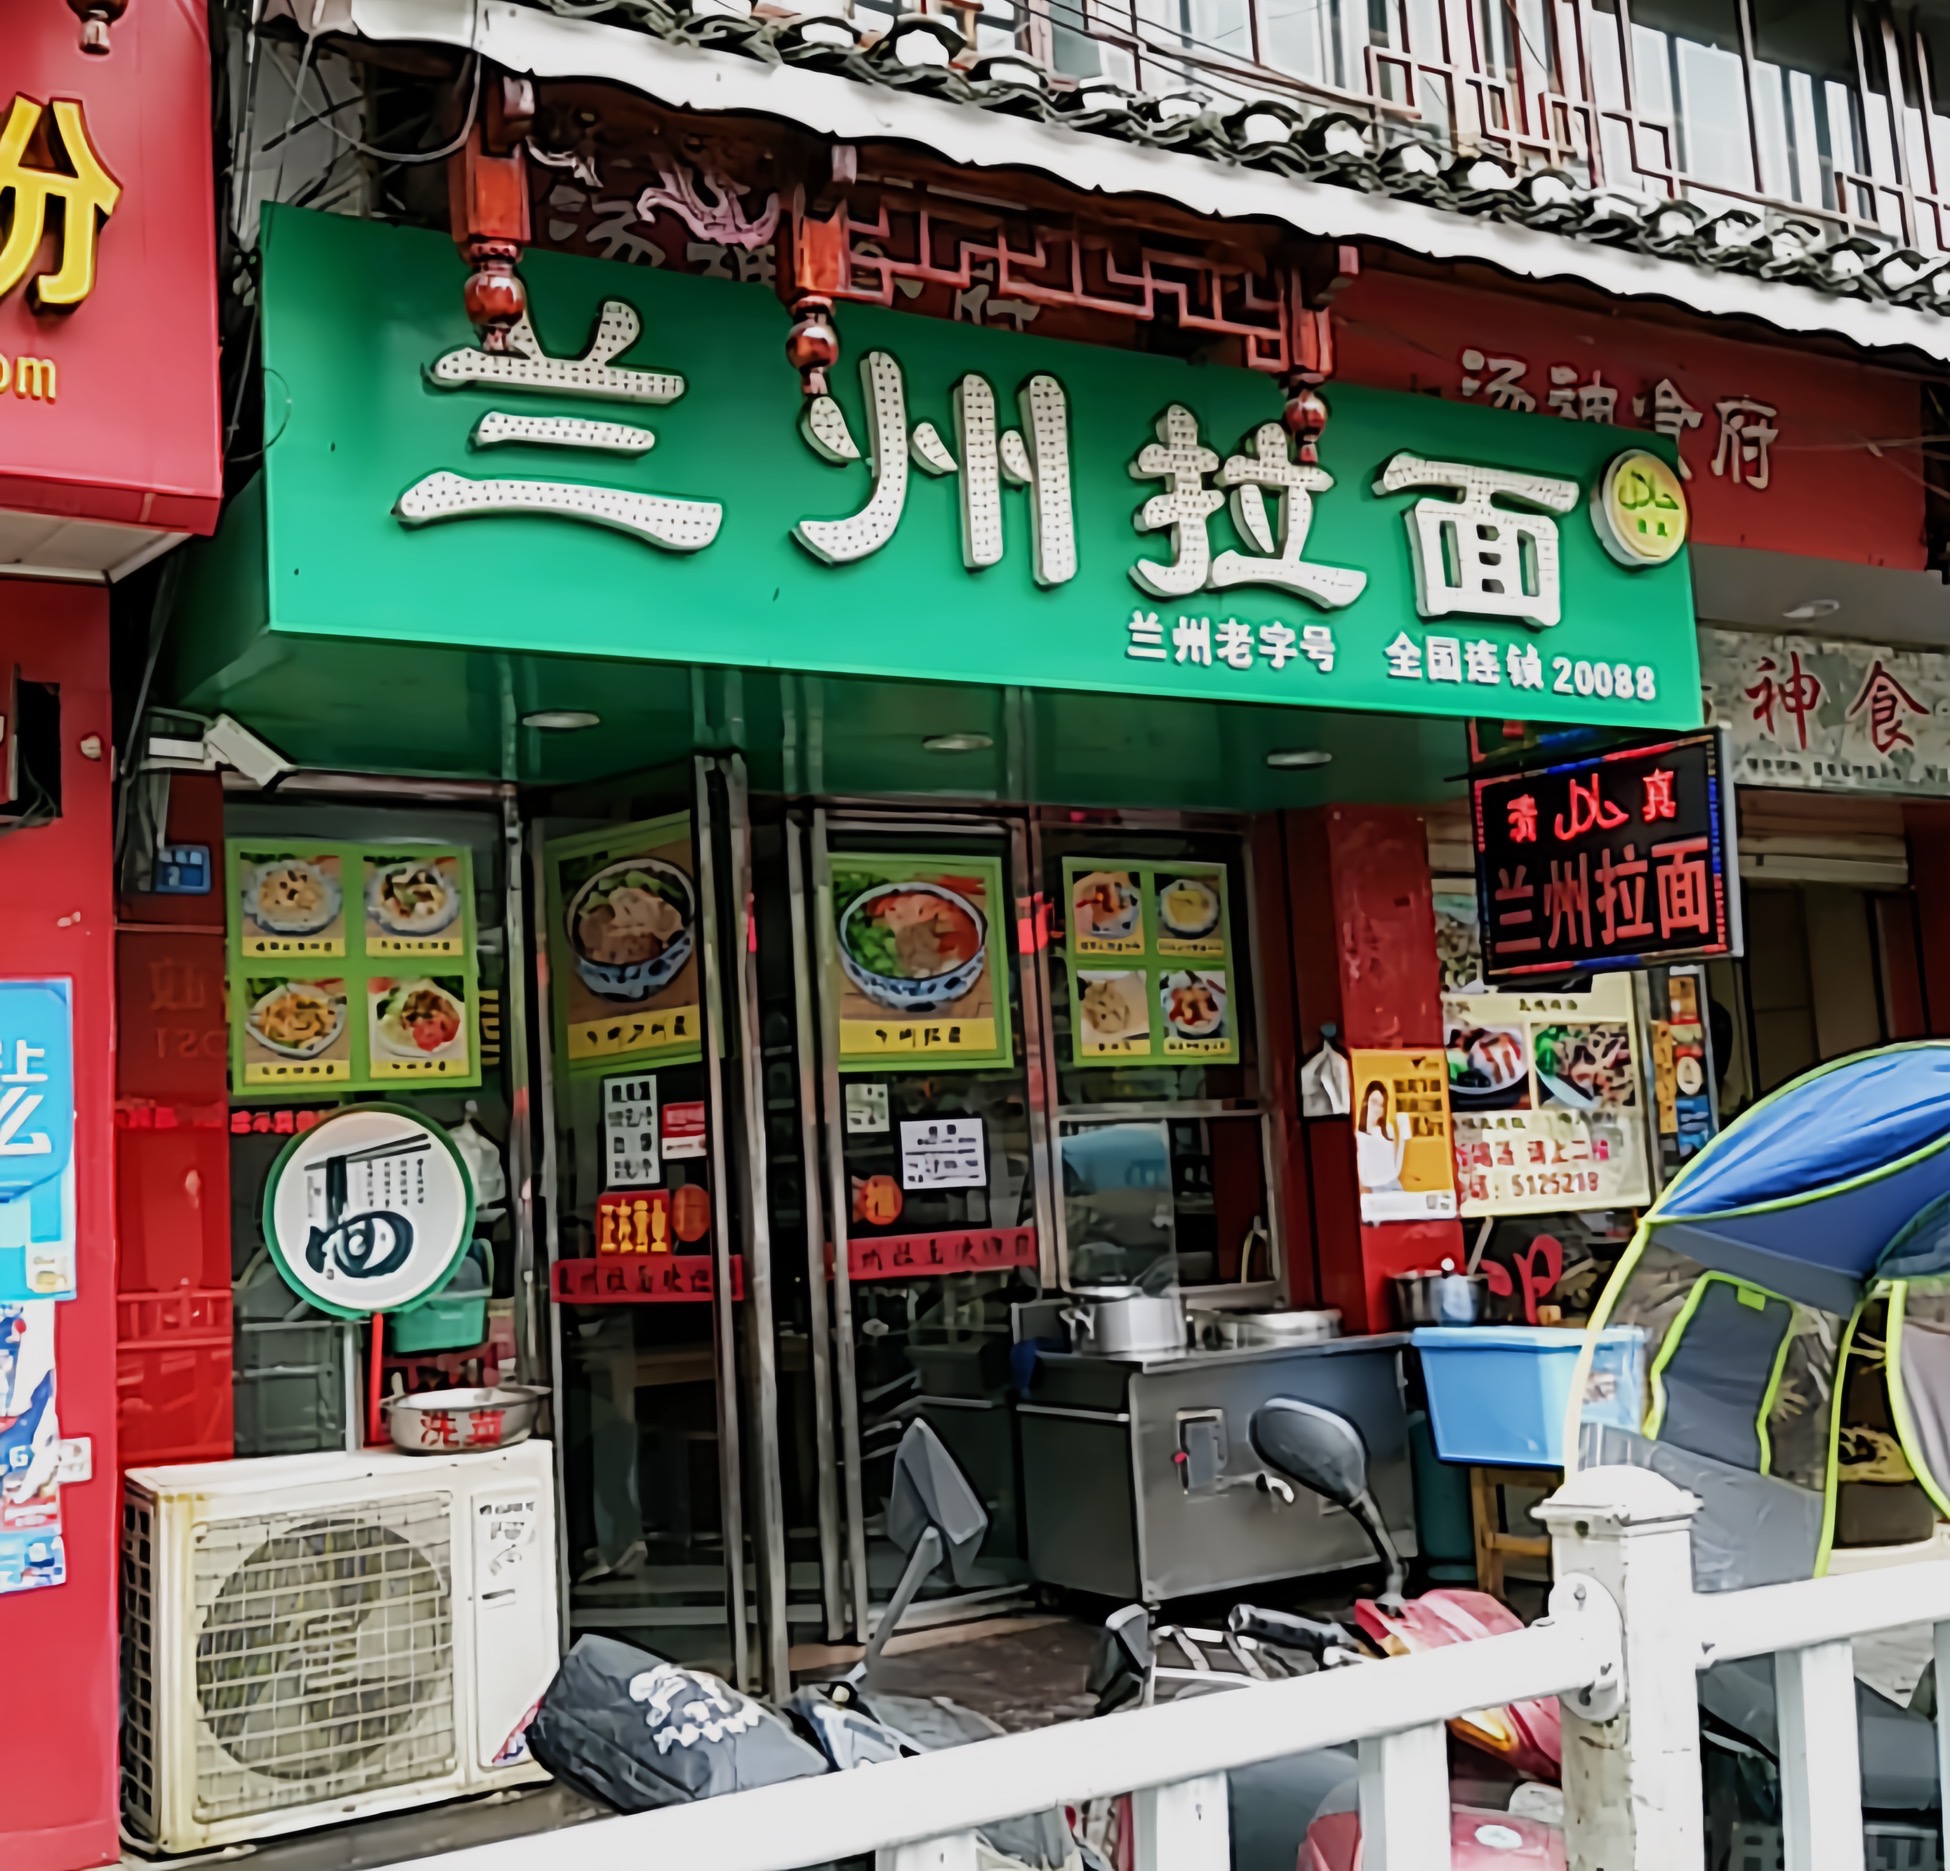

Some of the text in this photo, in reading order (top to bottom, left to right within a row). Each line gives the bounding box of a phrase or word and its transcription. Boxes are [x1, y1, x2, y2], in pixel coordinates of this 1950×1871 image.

[396, 300, 1581, 628] 兰州拉面
[1126, 609, 1336, 673] 兰州老字号
[1384, 631, 1657, 701] 全国连锁 20088
[1743, 650, 1931, 754] 神食
[1494, 837, 1710, 954] 兰州拉面
